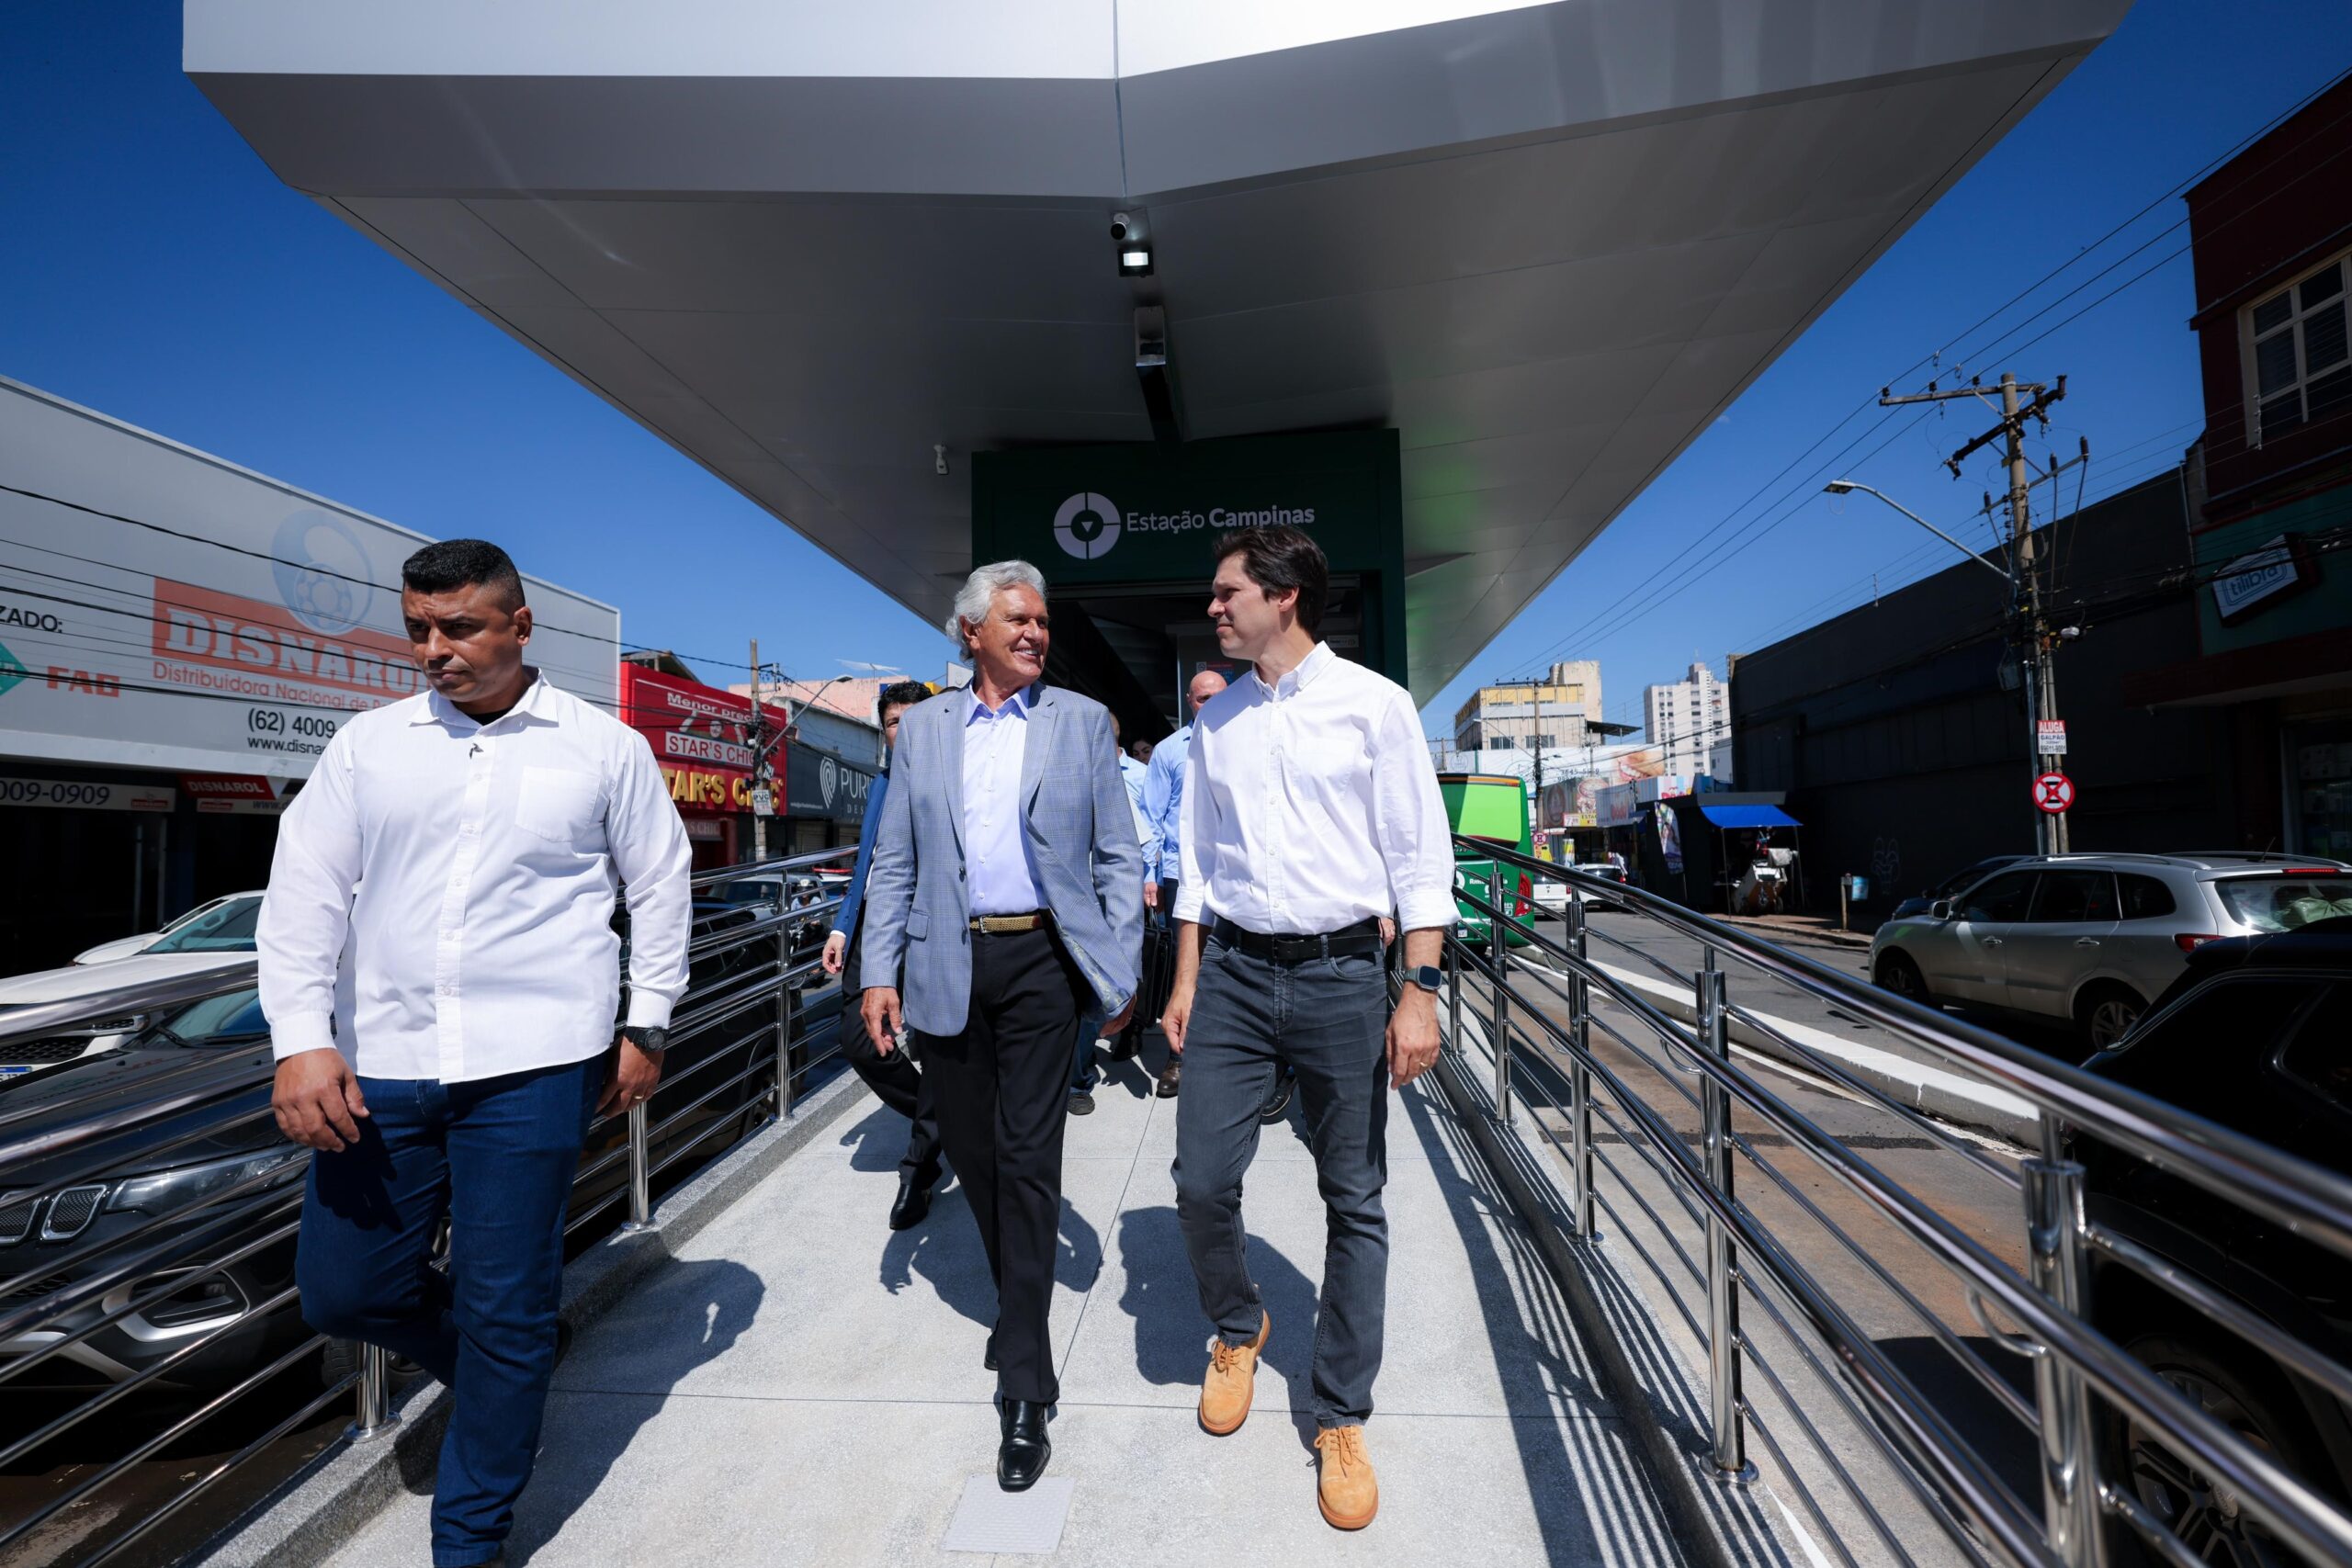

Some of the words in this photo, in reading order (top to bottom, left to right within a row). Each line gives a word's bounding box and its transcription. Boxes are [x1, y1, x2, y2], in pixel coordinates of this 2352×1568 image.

[1126, 511, 1204, 534] Estação
[1209, 505, 1315, 528] Campinas
[164, 608, 427, 694] DISNARO
[47, 666, 119, 697] FAG
[153, 661, 270, 696] Distribuidora
[277, 683, 345, 709] Nacional
[350, 696, 368, 710] de
[667, 692, 718, 713] Menor
[248, 708, 285, 735] (62)
[2039, 721, 2065, 733] ALUGA
[669, 736, 722, 760] STAR'S
[187, 781, 265, 794] DISNAROL
[662, 768, 726, 805] TAR'S
